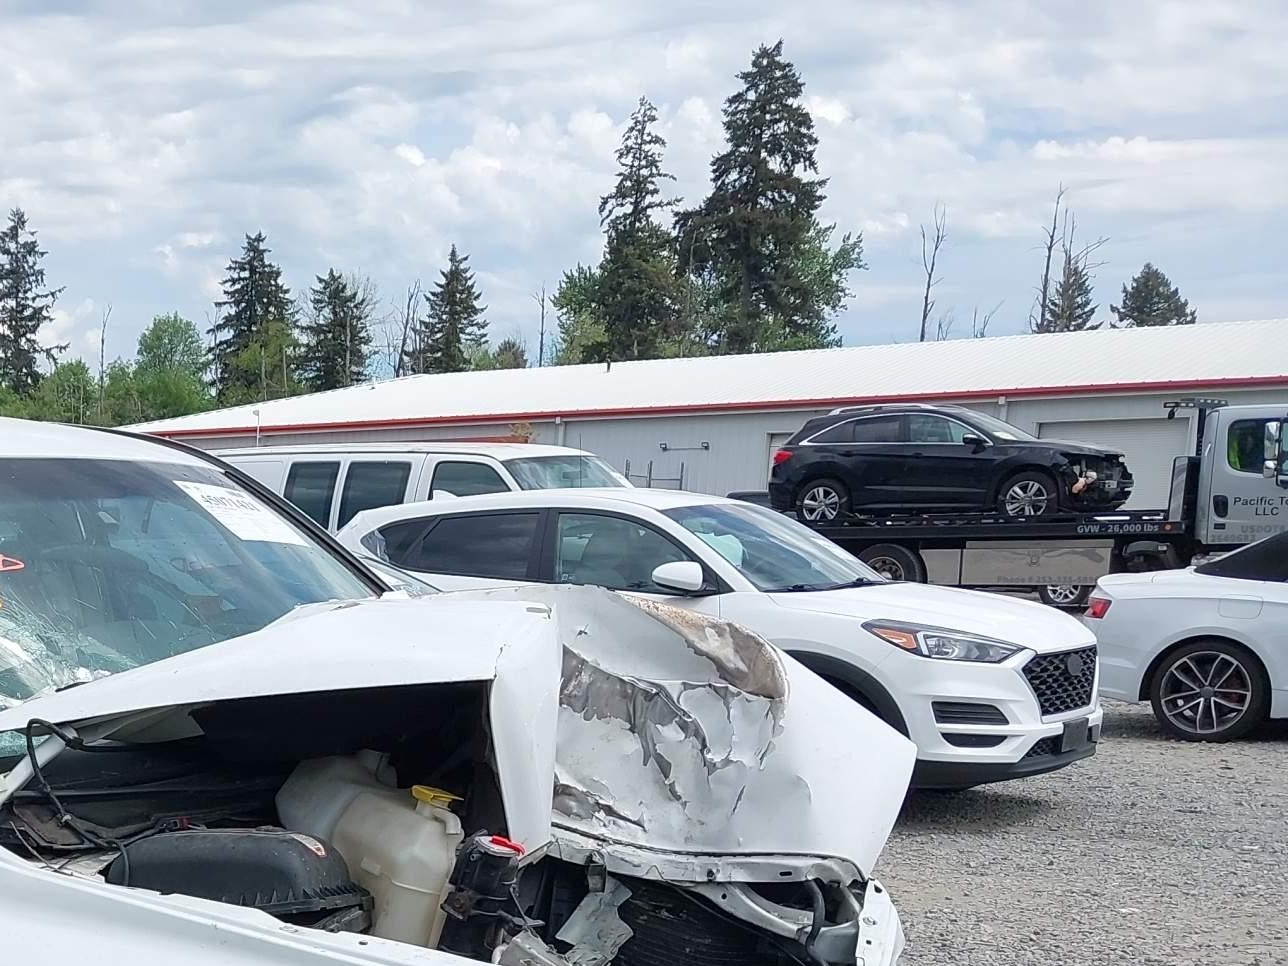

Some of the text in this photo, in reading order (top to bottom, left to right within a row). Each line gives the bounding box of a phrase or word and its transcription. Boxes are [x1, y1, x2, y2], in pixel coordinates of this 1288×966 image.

[1233, 496, 1274, 506] Pacific
[1255, 506, 1280, 516] LLC
[1076, 524, 1100, 534] GVW
[1143, 523, 1160, 532] lbs
